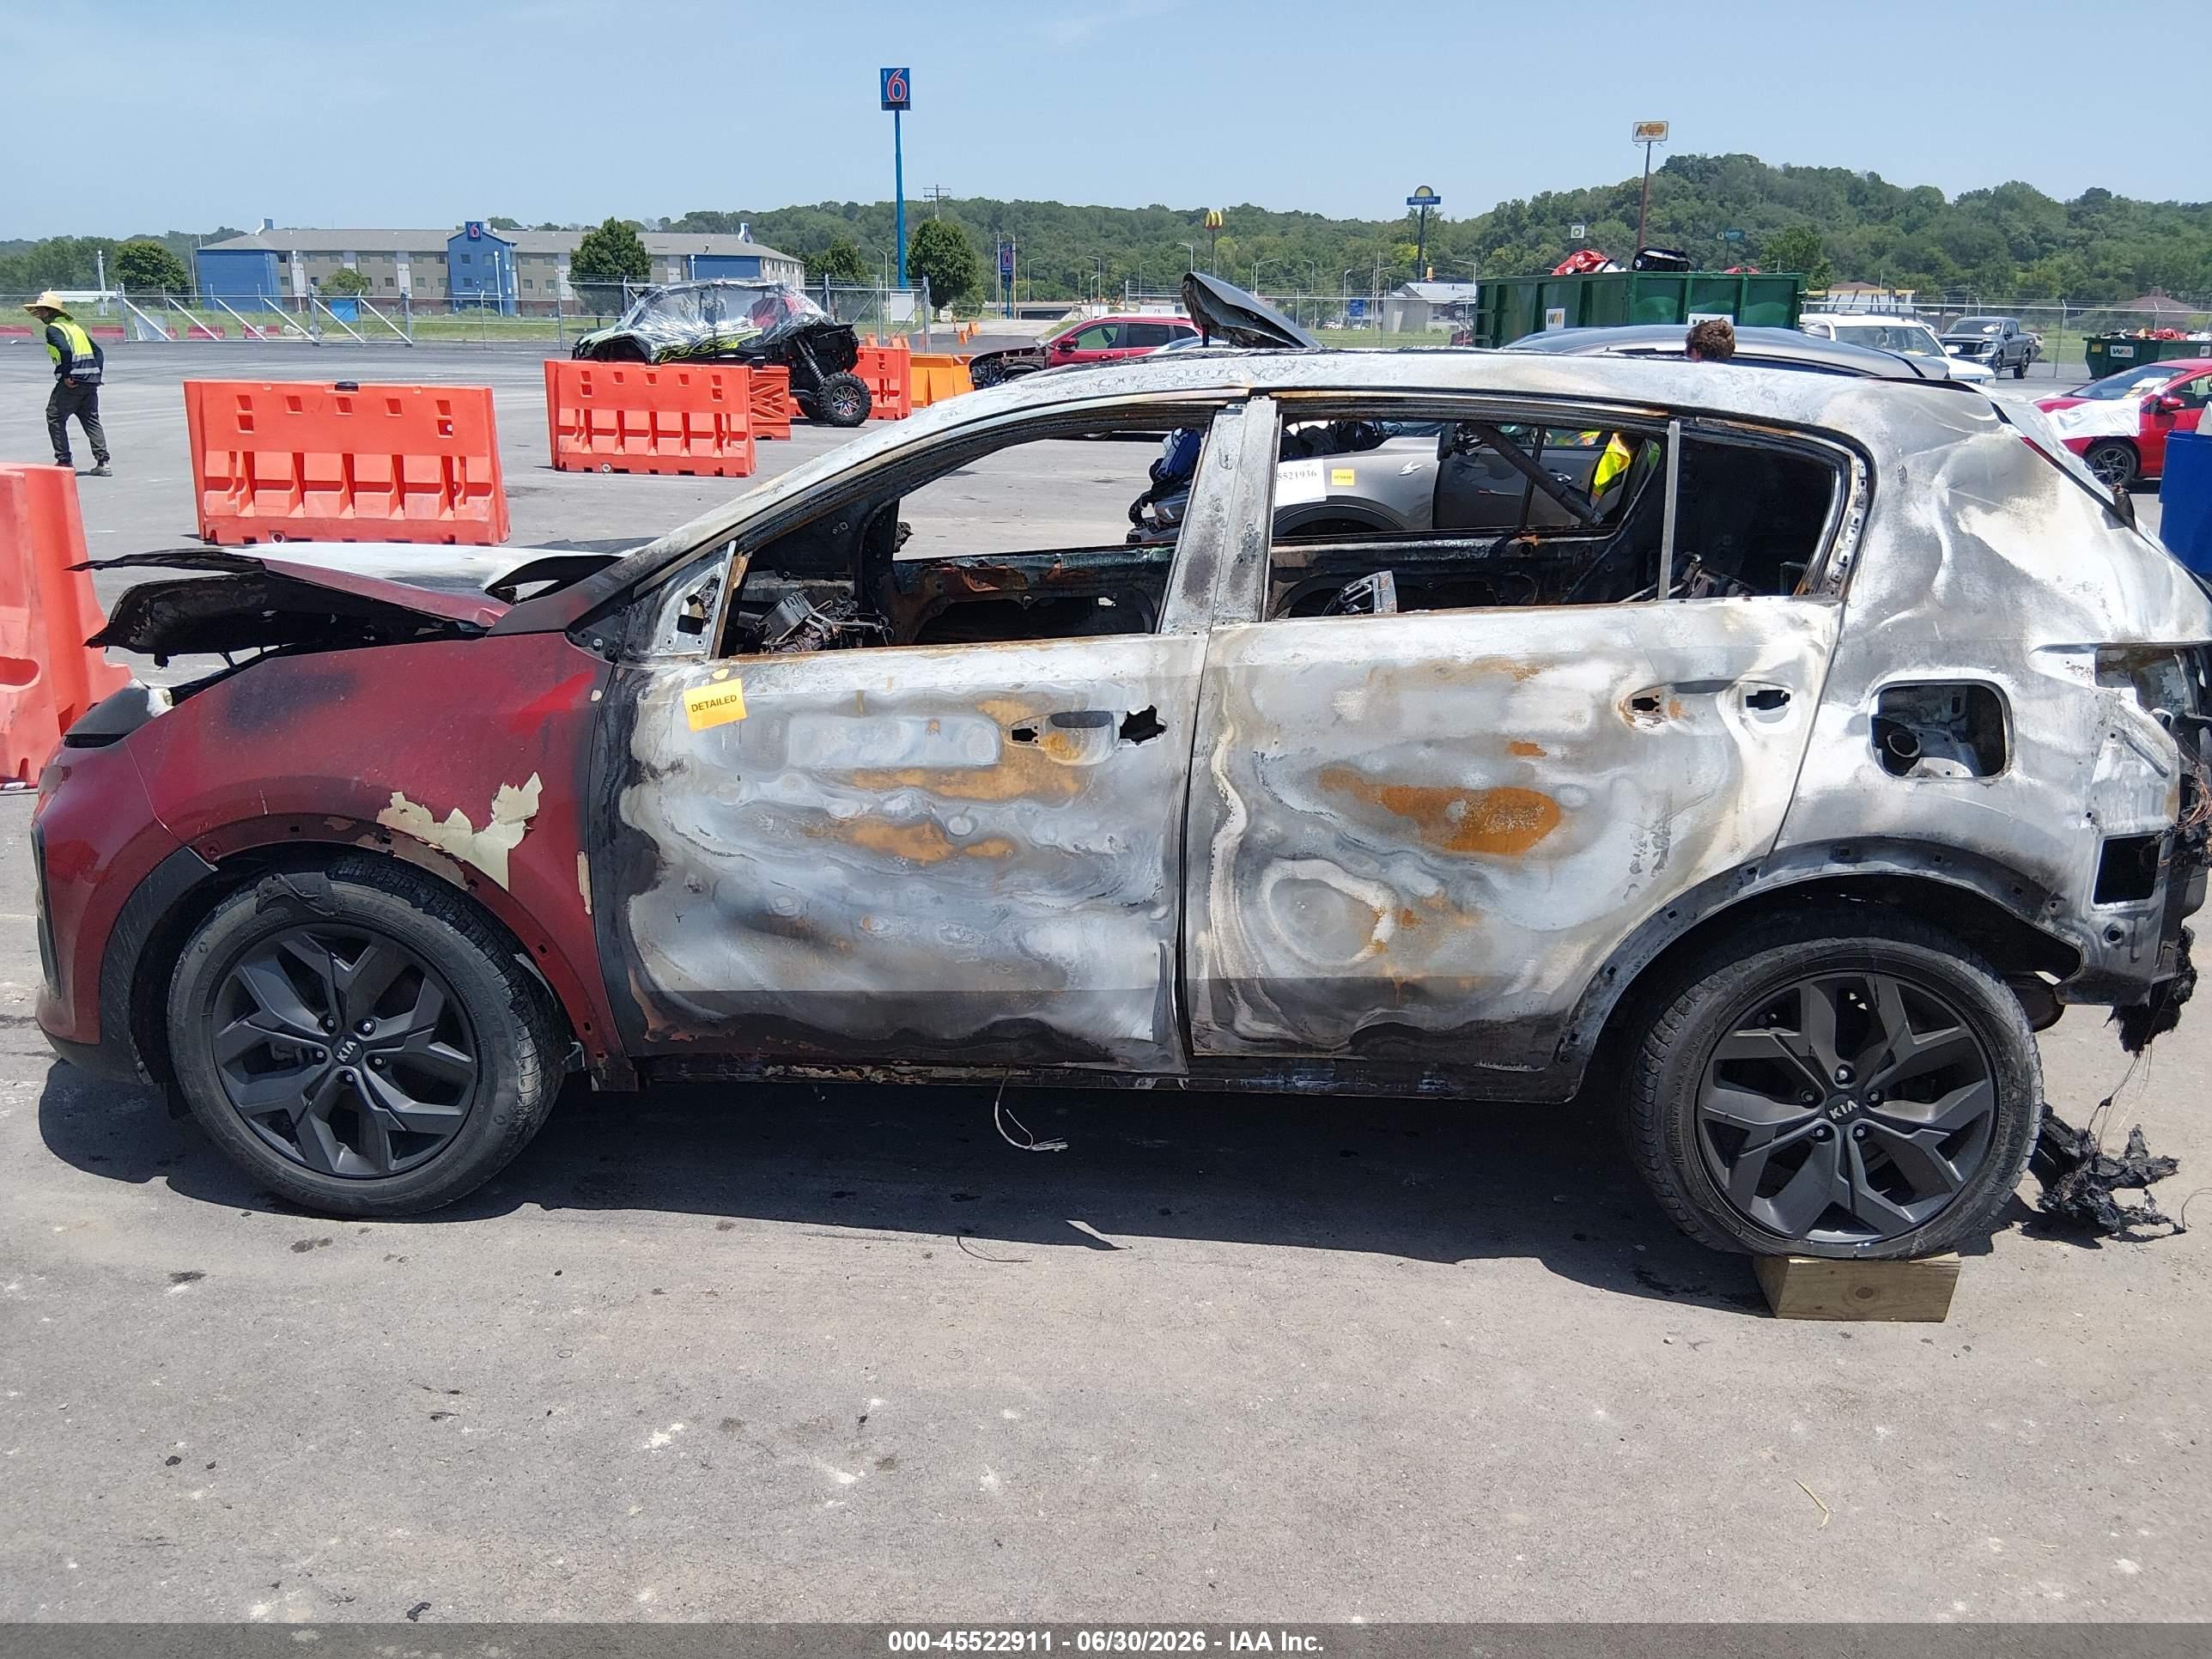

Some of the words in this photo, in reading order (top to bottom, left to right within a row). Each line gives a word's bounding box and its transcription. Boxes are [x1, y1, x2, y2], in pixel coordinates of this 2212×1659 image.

[887, 69, 908, 102] 6
[470, 223, 480, 238] 6
[1547, 313, 1562, 325] WM
[691, 695, 737, 713] DETAILED
[337, 1040, 358, 1063] KIA
[1828, 1099, 1859, 1120] KIA
